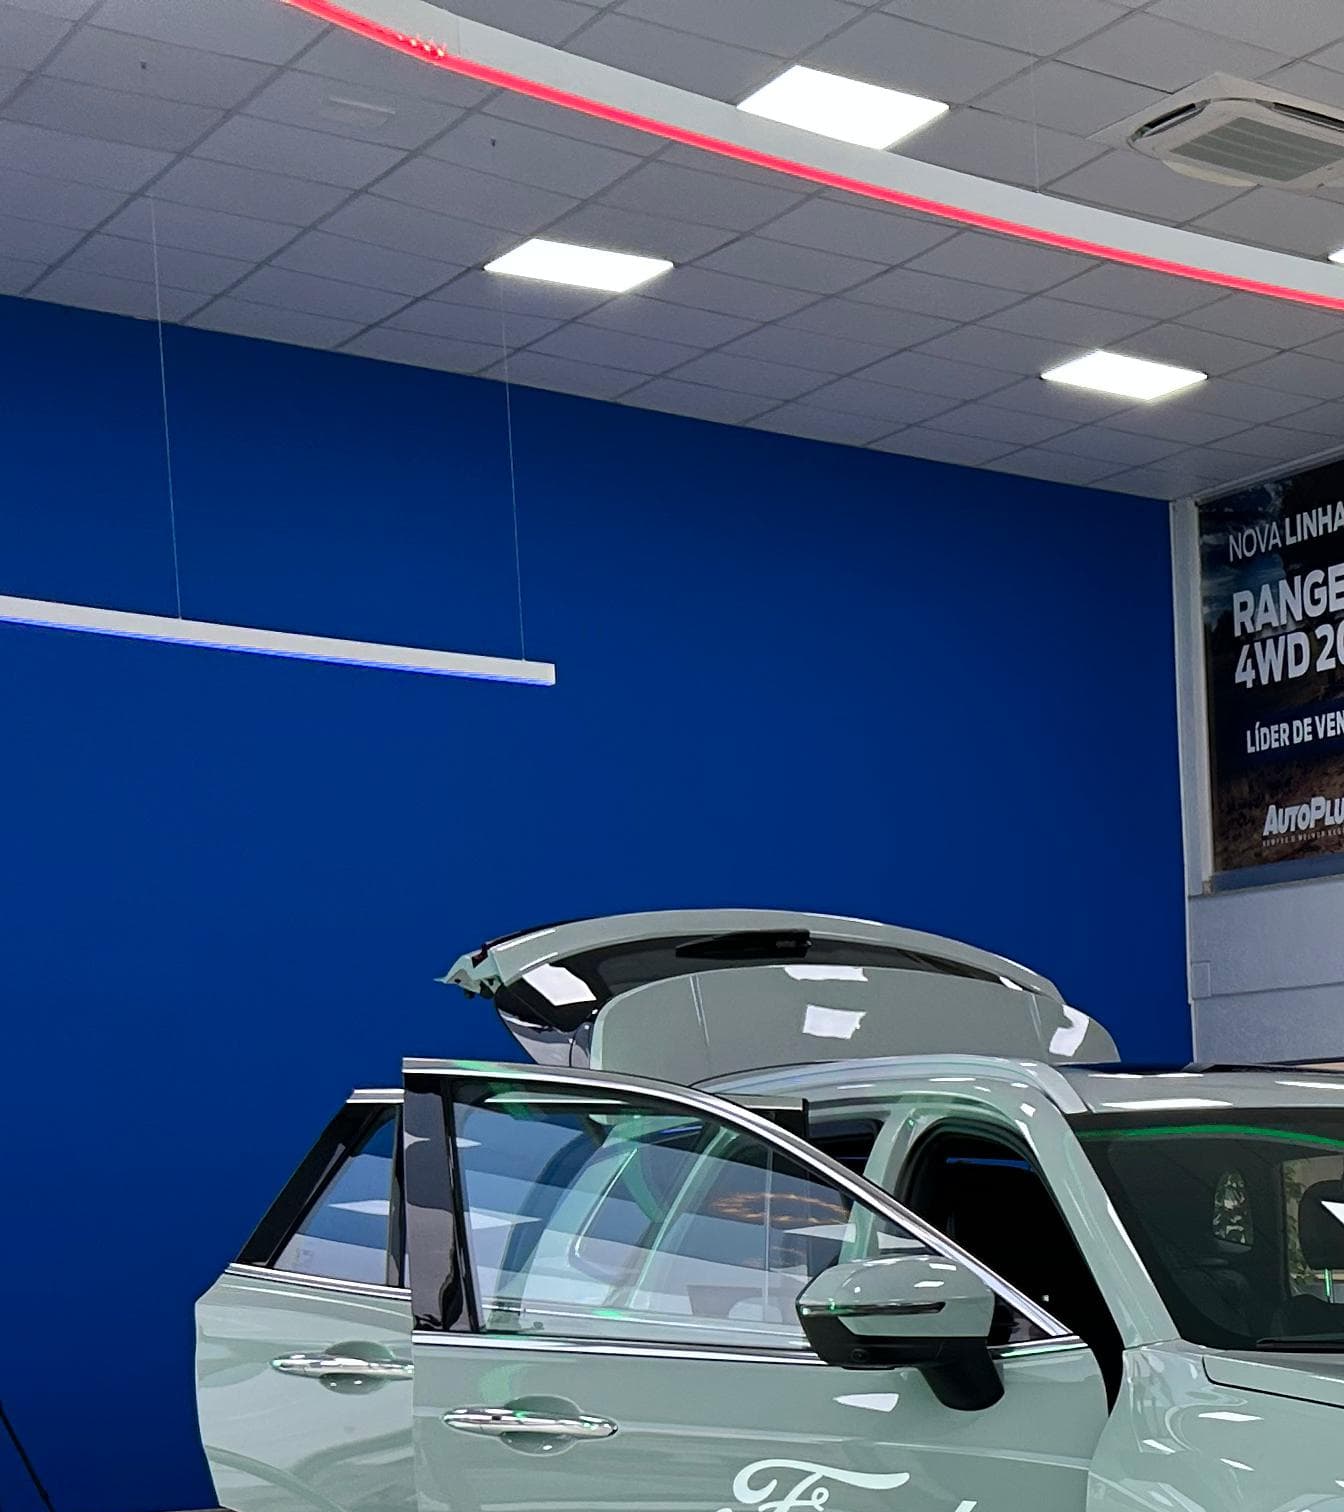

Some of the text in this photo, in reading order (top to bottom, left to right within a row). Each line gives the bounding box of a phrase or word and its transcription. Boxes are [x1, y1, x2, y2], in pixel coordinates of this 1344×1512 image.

[1229, 521, 1282, 562] NOVA
[1234, 631, 1311, 689] 4WD
[1247, 721, 1290, 754] LÍDER
[1292, 716, 1314, 744] DE
